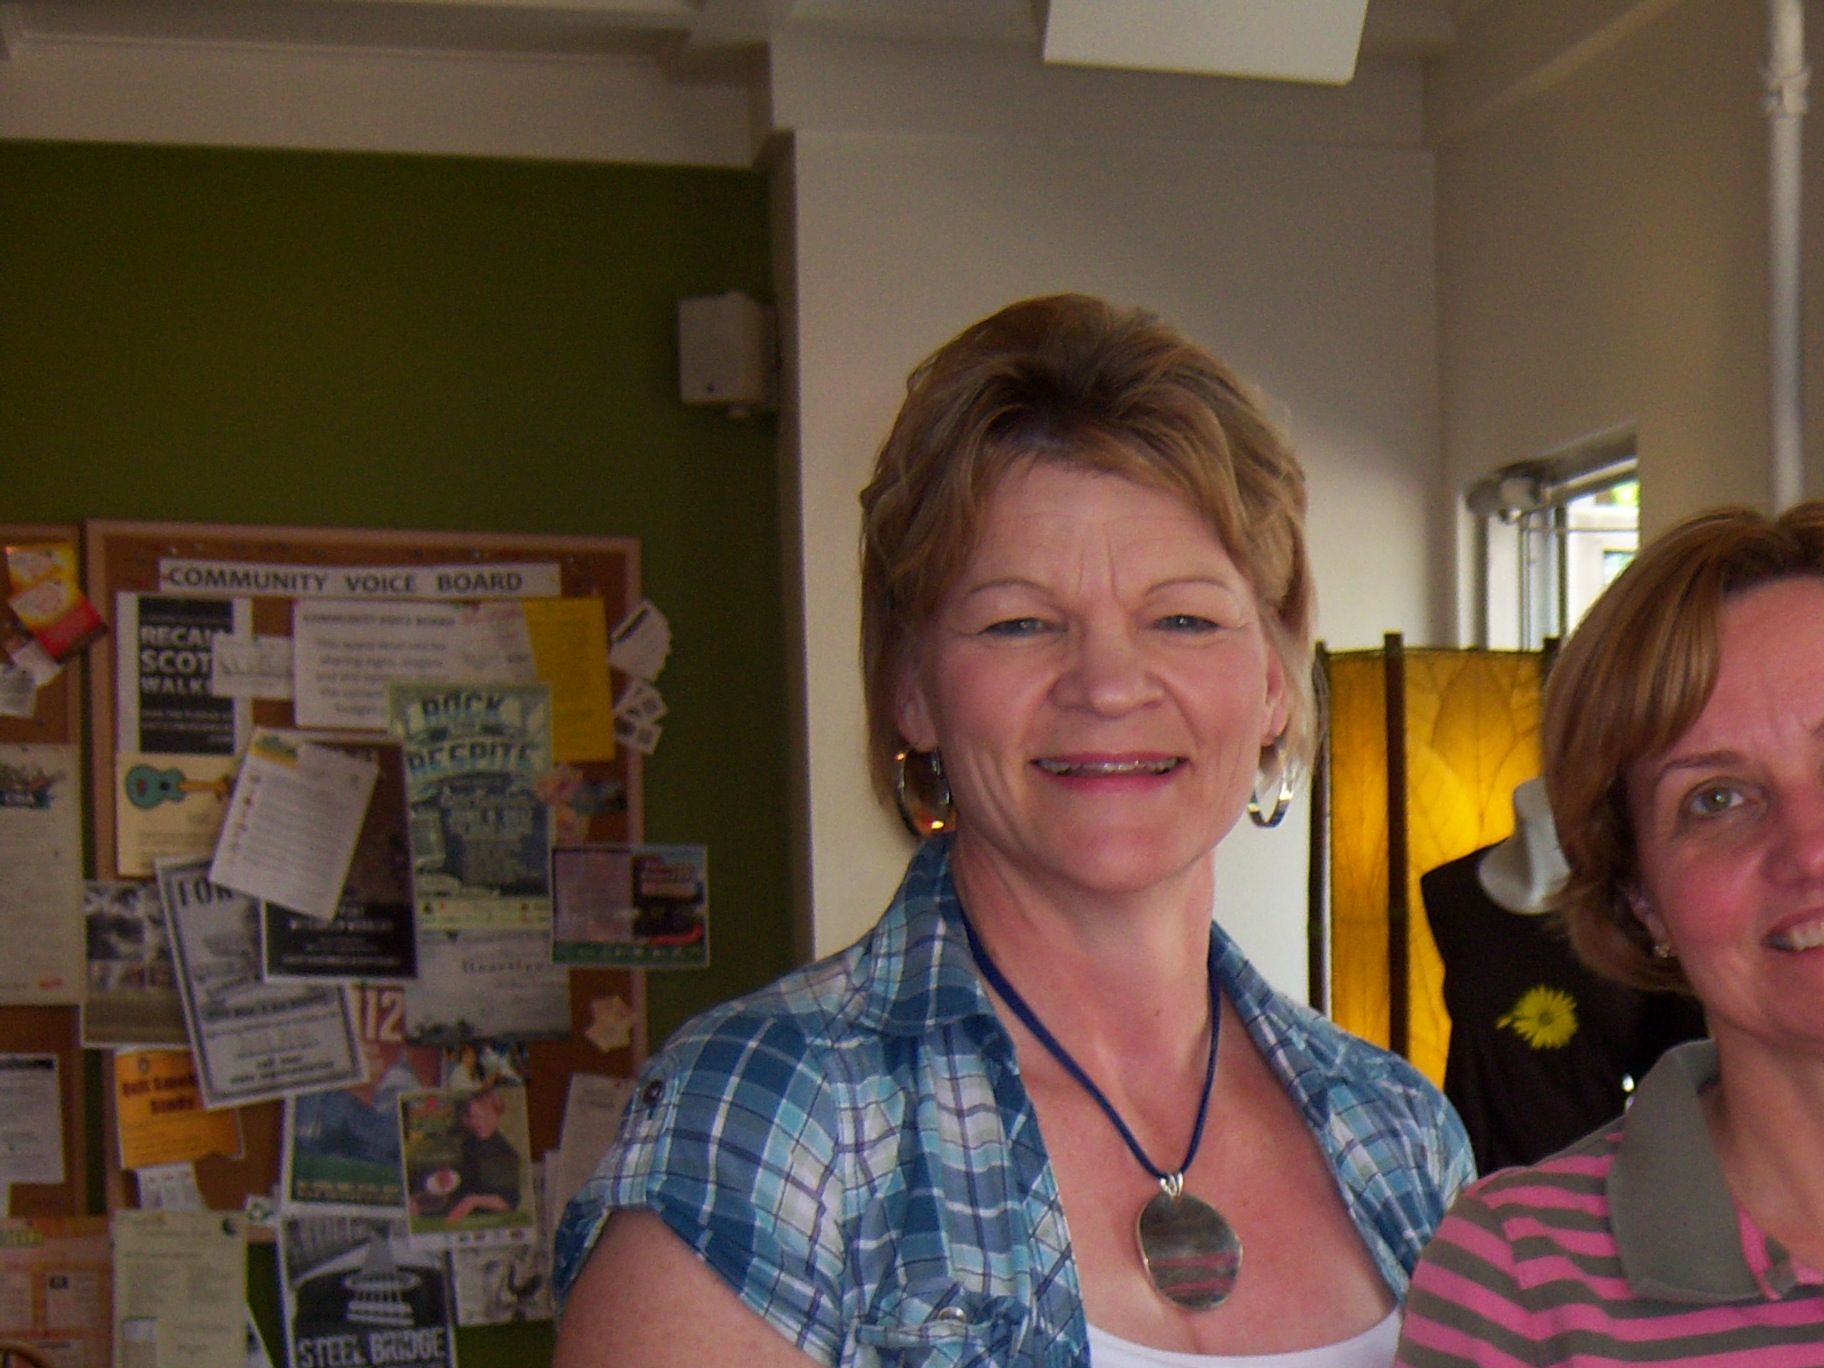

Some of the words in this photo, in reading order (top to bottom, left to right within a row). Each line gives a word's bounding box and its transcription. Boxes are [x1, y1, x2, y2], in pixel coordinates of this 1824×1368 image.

[168, 566, 327, 592] COMMUNITY
[345, 574, 416, 593] VOICE
[437, 572, 523, 592] BOARD
[369, 1327, 446, 1365] BRIDGE
